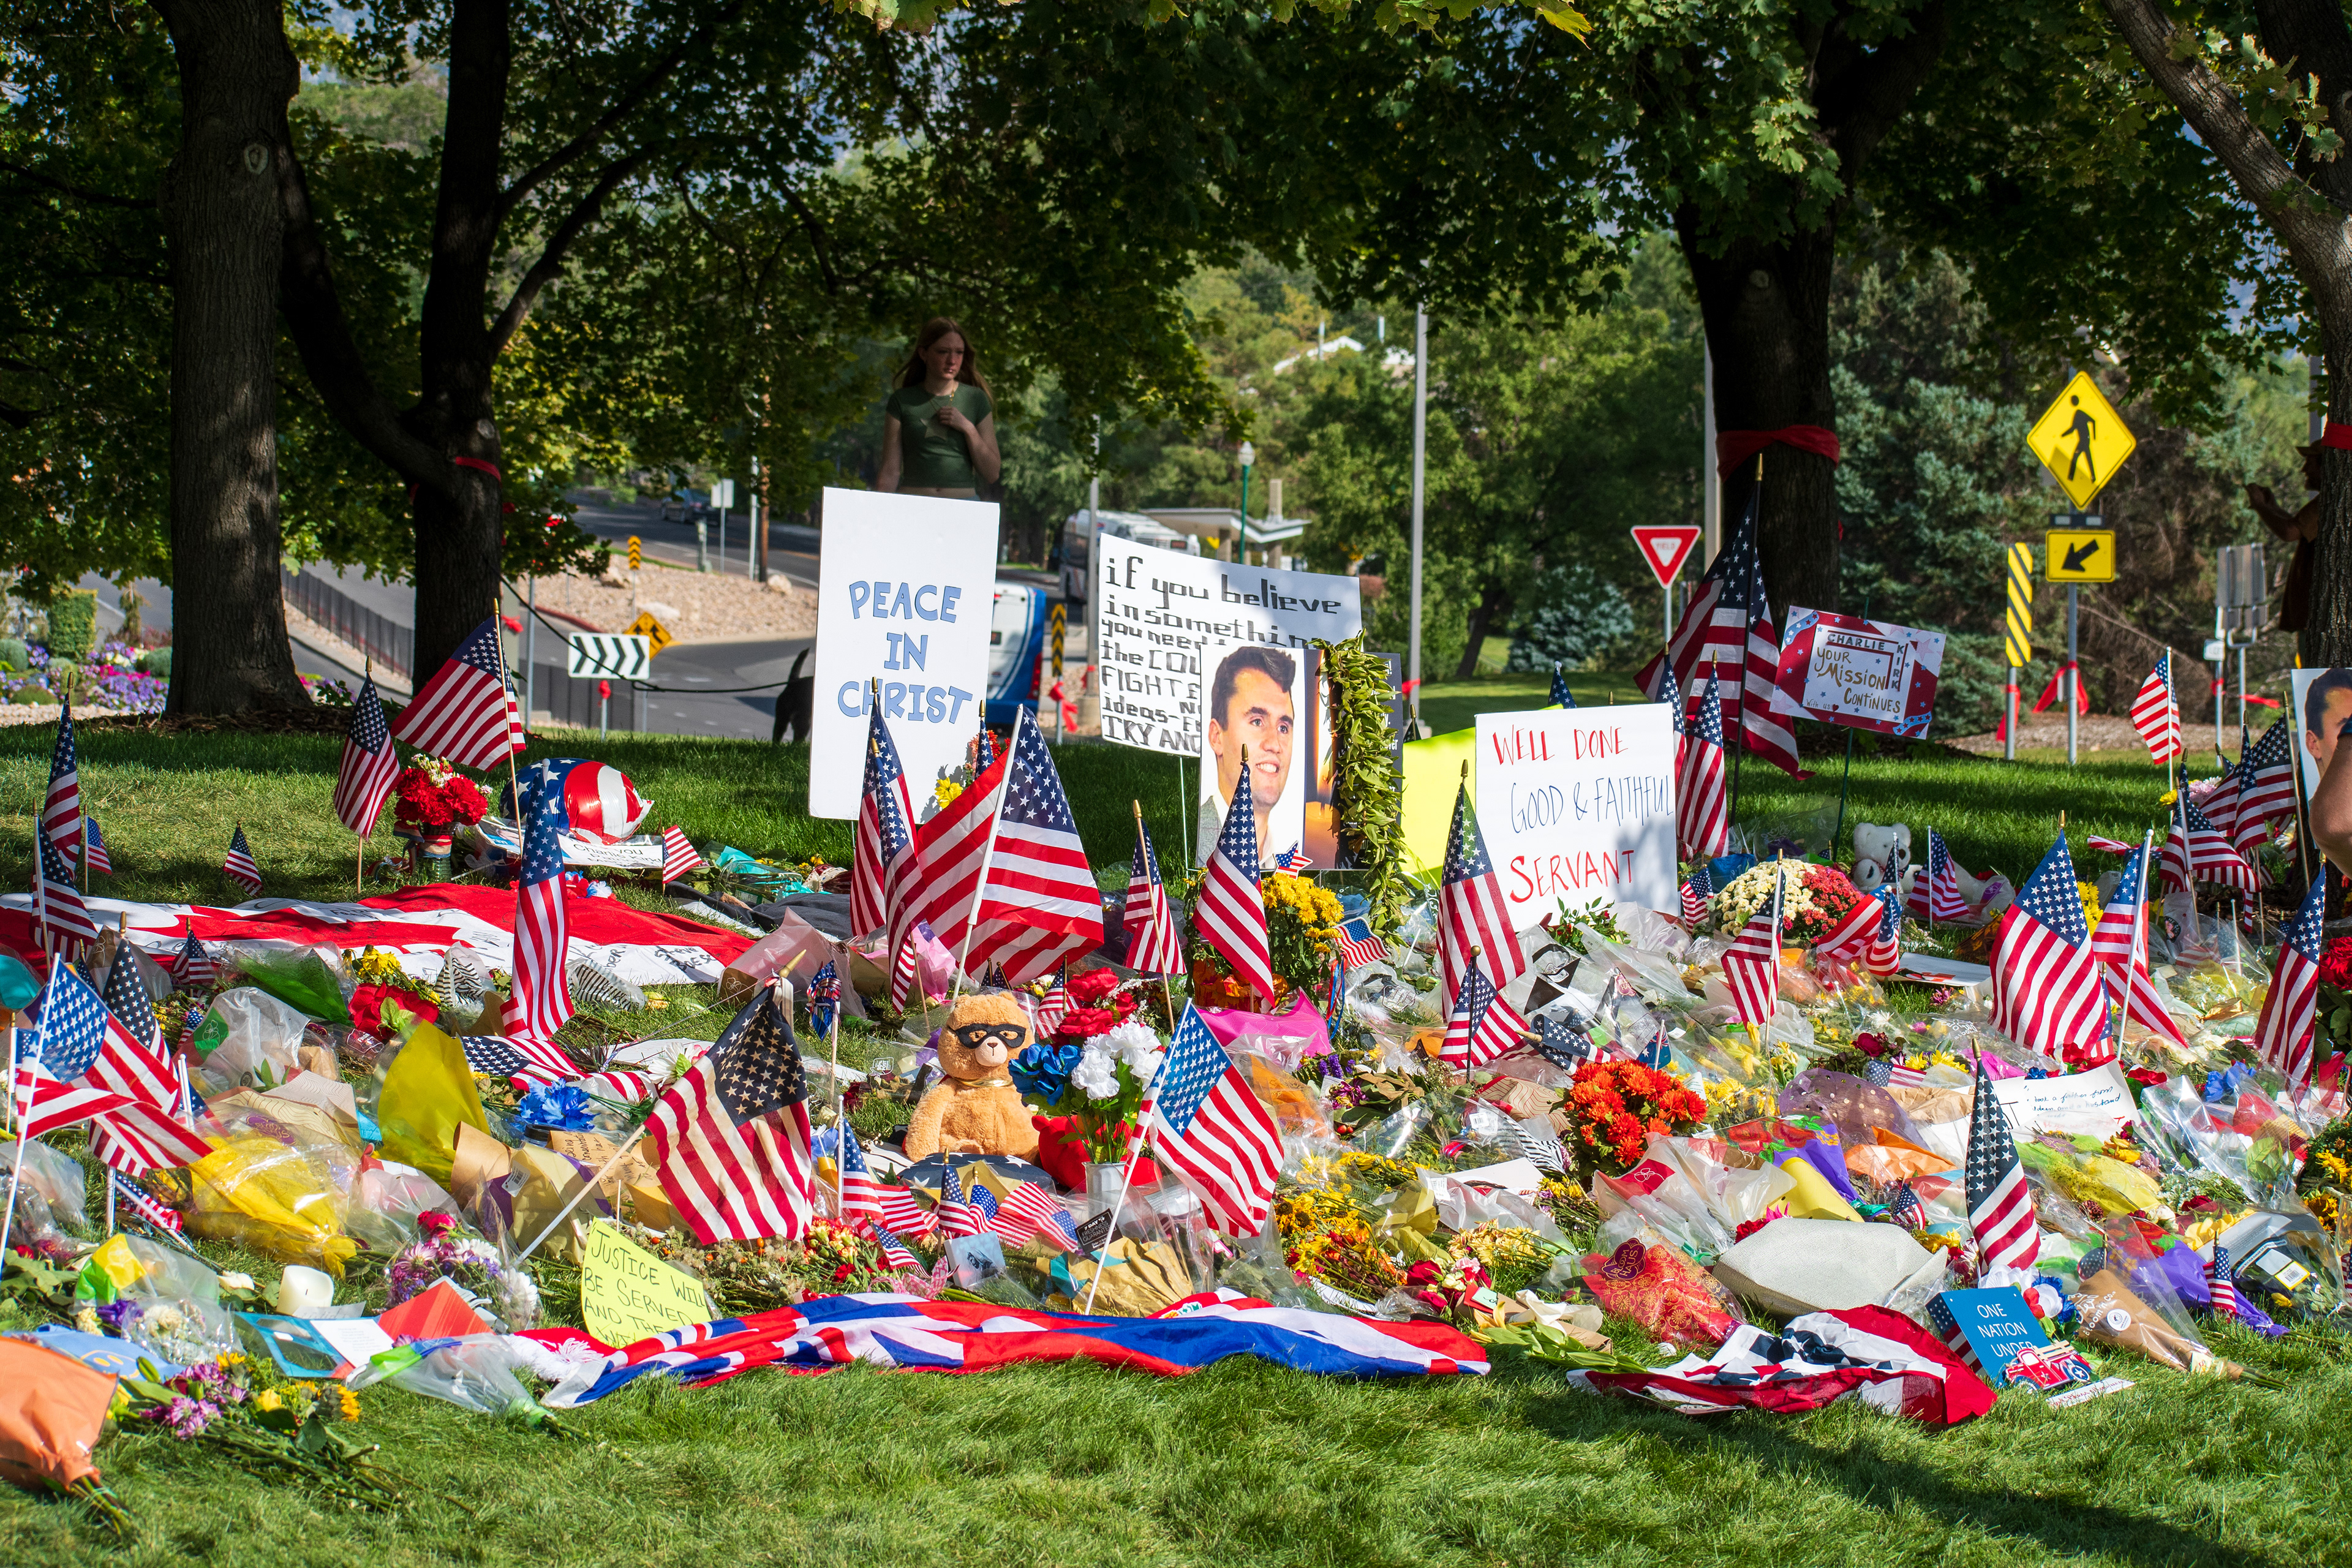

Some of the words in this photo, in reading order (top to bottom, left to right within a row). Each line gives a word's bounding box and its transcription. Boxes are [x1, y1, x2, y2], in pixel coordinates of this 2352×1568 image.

[850, 581, 962, 623] PEACE
[1106, 556, 1143, 589] if
[1152, 578, 1208, 609] you
[1221, 573, 1341, 614] believe
[1102, 619, 1142, 638] you
[1828, 633, 1885, 650] CHARLIE
[884, 631, 928, 671] IN
[1101, 639, 1144, 666] the
[1891, 645, 1905, 689] KIRK
[1101, 665, 1183, 697] FIGHT
[838, 678, 973, 724] CHRIST
[1493, 725, 1555, 765] WELL
[1574, 726, 1628, 760] DONE
[1512, 782, 1563, 833] GOOD
[1574, 782, 1588, 820] &
[1594, 775, 1673, 826] FAITHFUL
[1510, 850, 1634, 903] SERVANT
[1082, 1220, 1109, 1237] FRESHNESS
[1088, 1219, 1099, 1229] DAY
[1619, 1250, 1638, 1276] HAUS
[584, 1267, 604, 1296] BE
[617, 1279, 693, 1326] SERVED
[671, 1275, 706, 1308] WILL
[584, 1297, 622, 1324] AND
[627, 1314, 664, 1335] THE
[1977, 1303, 2007, 1318] ONE
[1977, 1322, 2028, 1338] NATION
